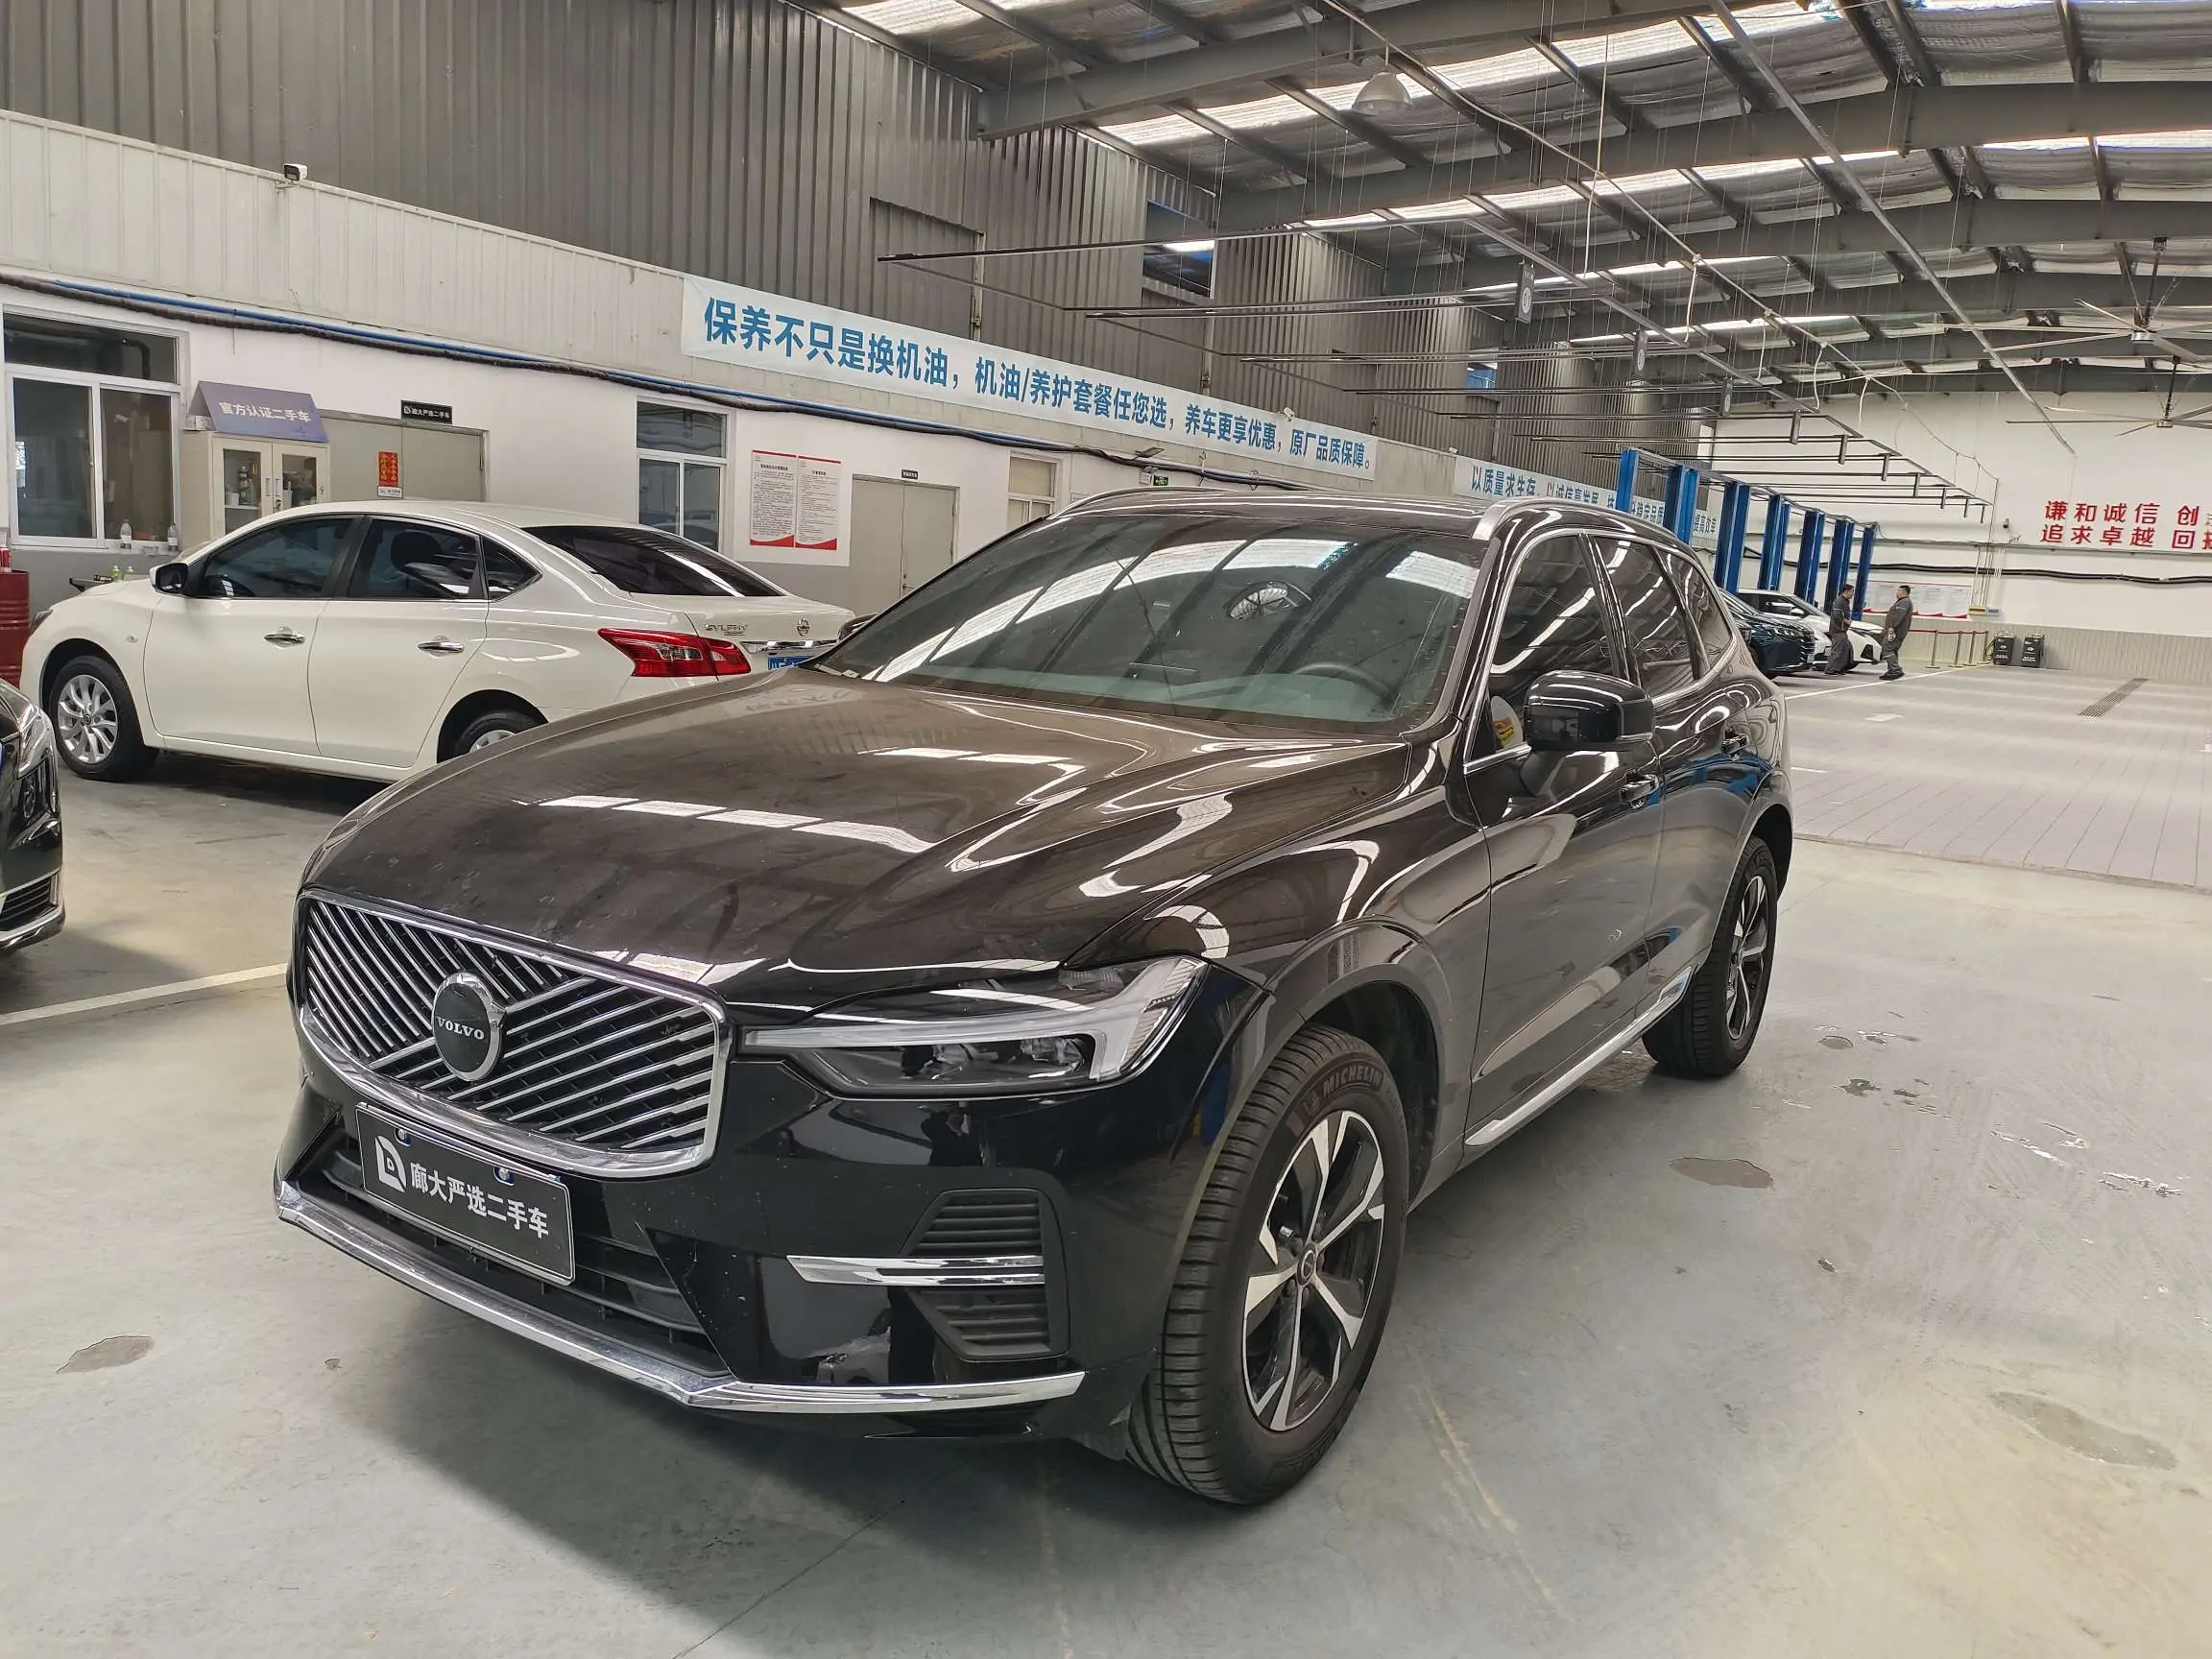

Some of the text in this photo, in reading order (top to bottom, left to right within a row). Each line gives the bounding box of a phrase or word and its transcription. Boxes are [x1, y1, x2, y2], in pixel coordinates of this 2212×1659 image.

[219, 402, 311, 422] 官方认证二手车
[2045, 500, 2160, 524] 谦和诚信
[2040, 524, 2155, 548] 追求卓越
[437, 1016, 485, 1040] VOLVO
[1323, 1065, 1382, 1097] MICHELIN
[410, 1162, 550, 1239] 廊大严选二手车
